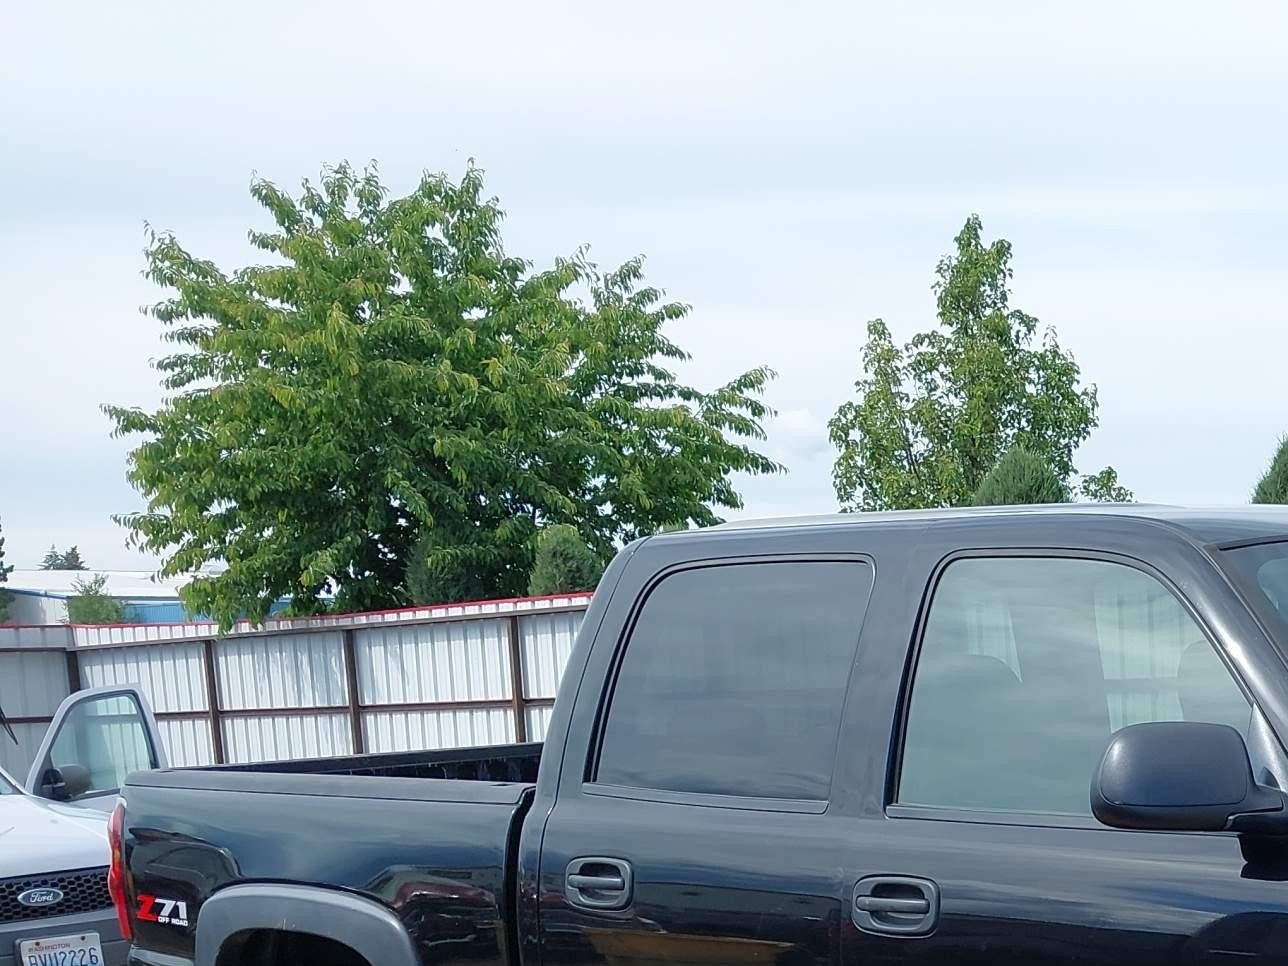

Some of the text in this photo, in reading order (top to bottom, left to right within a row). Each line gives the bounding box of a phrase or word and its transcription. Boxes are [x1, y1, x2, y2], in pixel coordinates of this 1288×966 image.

[30, 891, 54, 903] Ford
[137, 895, 187, 920] Z71
[171, 918, 188, 926] ROAD
